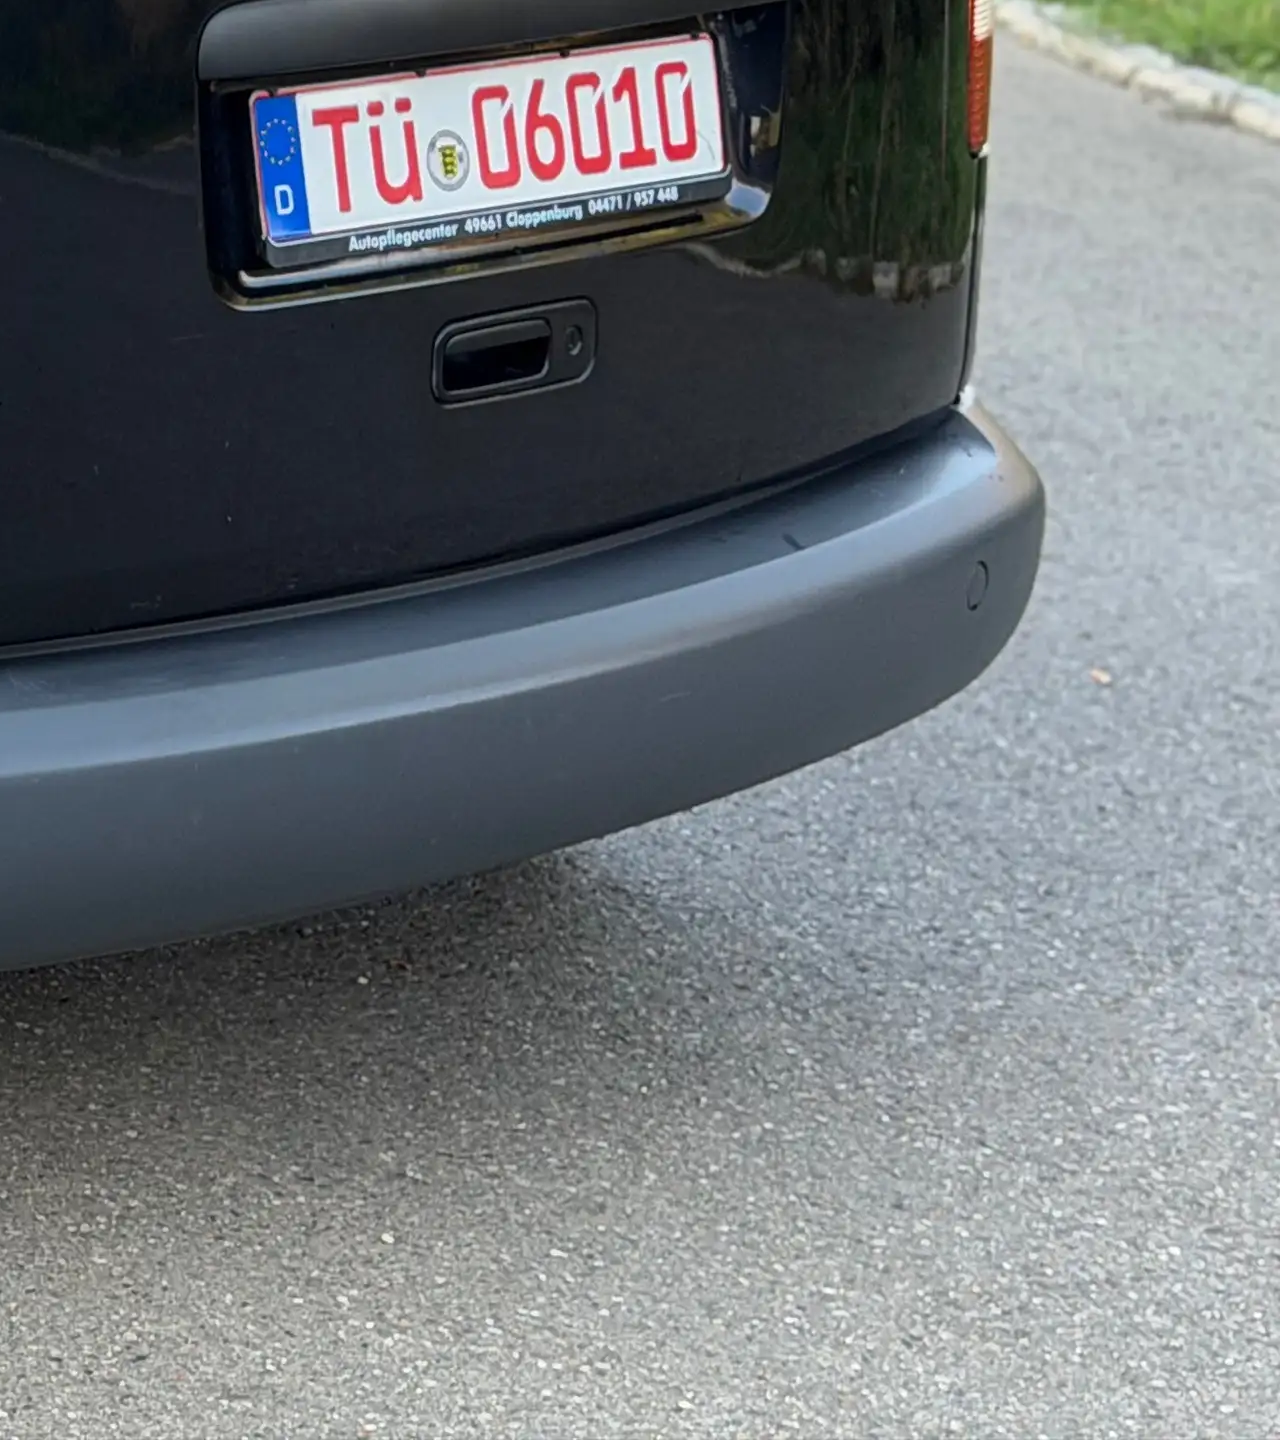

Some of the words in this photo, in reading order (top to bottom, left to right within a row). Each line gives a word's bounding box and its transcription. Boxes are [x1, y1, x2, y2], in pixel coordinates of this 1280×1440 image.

[311, 96, 423, 213] TÜ
[472, 60, 698, 190] 06010
[274, 183, 295, 216] D
[348, 224, 459, 253] Autopflegecenter
[464, 216, 503, 235] 49661
[506, 203, 584, 230] Cloppenburg
[588, 195, 624, 216] 04471
